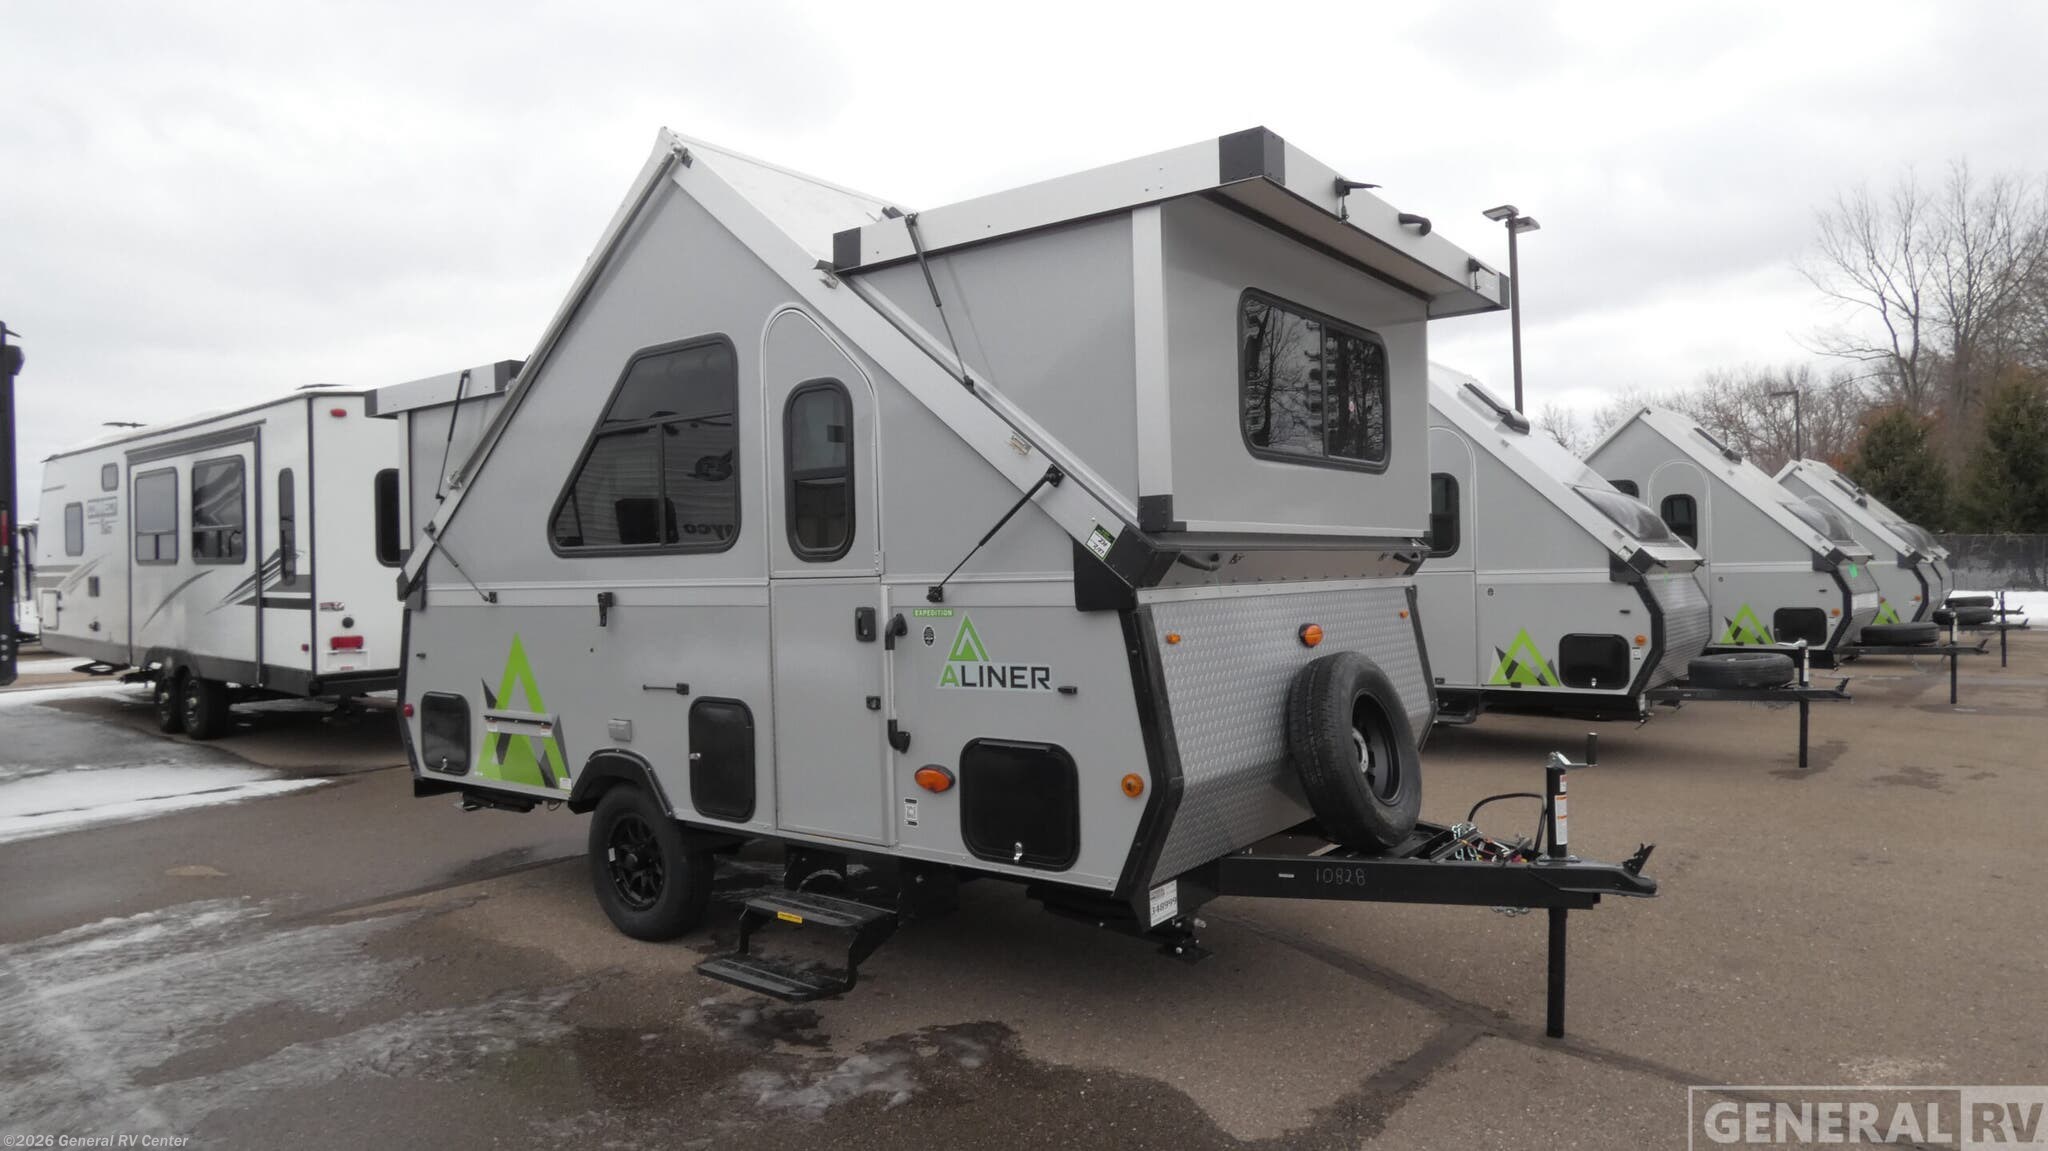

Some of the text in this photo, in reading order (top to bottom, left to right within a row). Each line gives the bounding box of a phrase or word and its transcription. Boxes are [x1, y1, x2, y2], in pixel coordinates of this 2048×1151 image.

[914, 609, 953, 617] EXPEDITION
[940, 664, 1051, 690] ALINER
[1316, 868, 1366, 886] 10828
